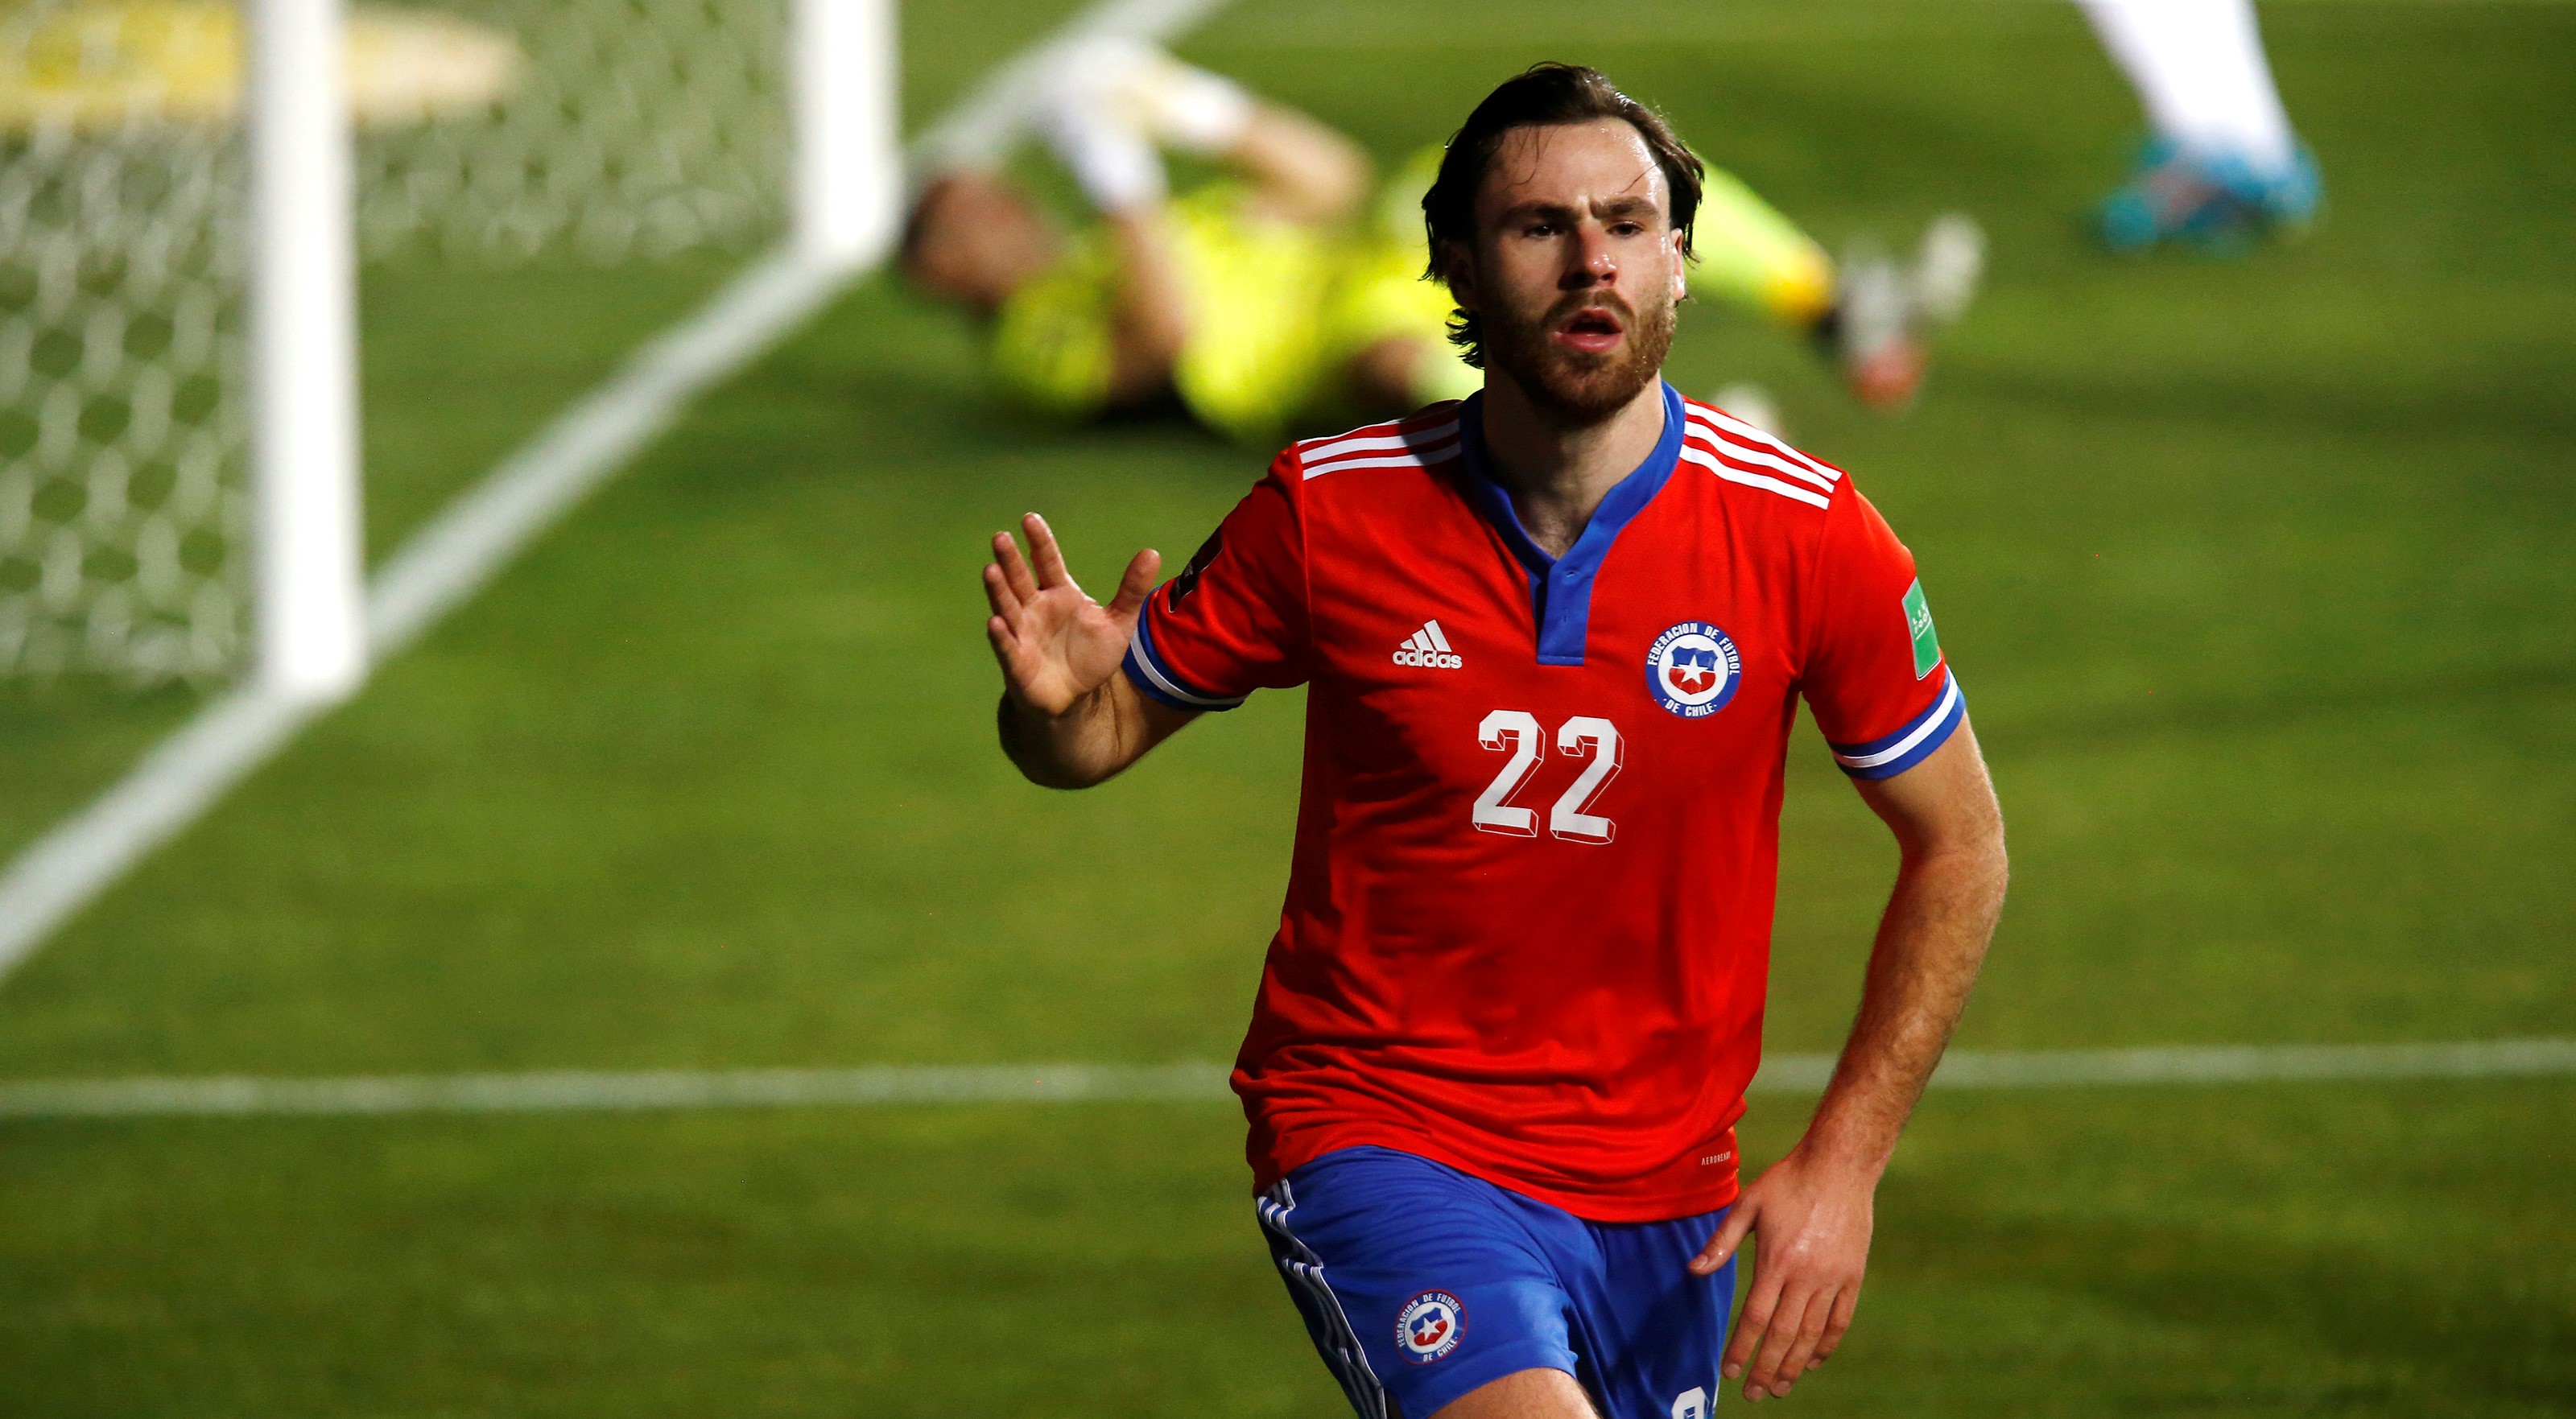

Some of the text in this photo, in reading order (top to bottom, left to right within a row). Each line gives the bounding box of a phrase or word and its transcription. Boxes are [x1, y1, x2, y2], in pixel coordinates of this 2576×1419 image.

[1393, 649, 1463, 669] adidas
[1647, 623, 1740, 675] FEDERACION DE FUTBOL
[1665, 699, 1715, 717] DE CHILE
[1472, 709, 1624, 845] 22
[1397, 1293, 1461, 1347] FEDERACION DE FUTBOL
[1422, 1338, 1458, 1362] DE CHILE
